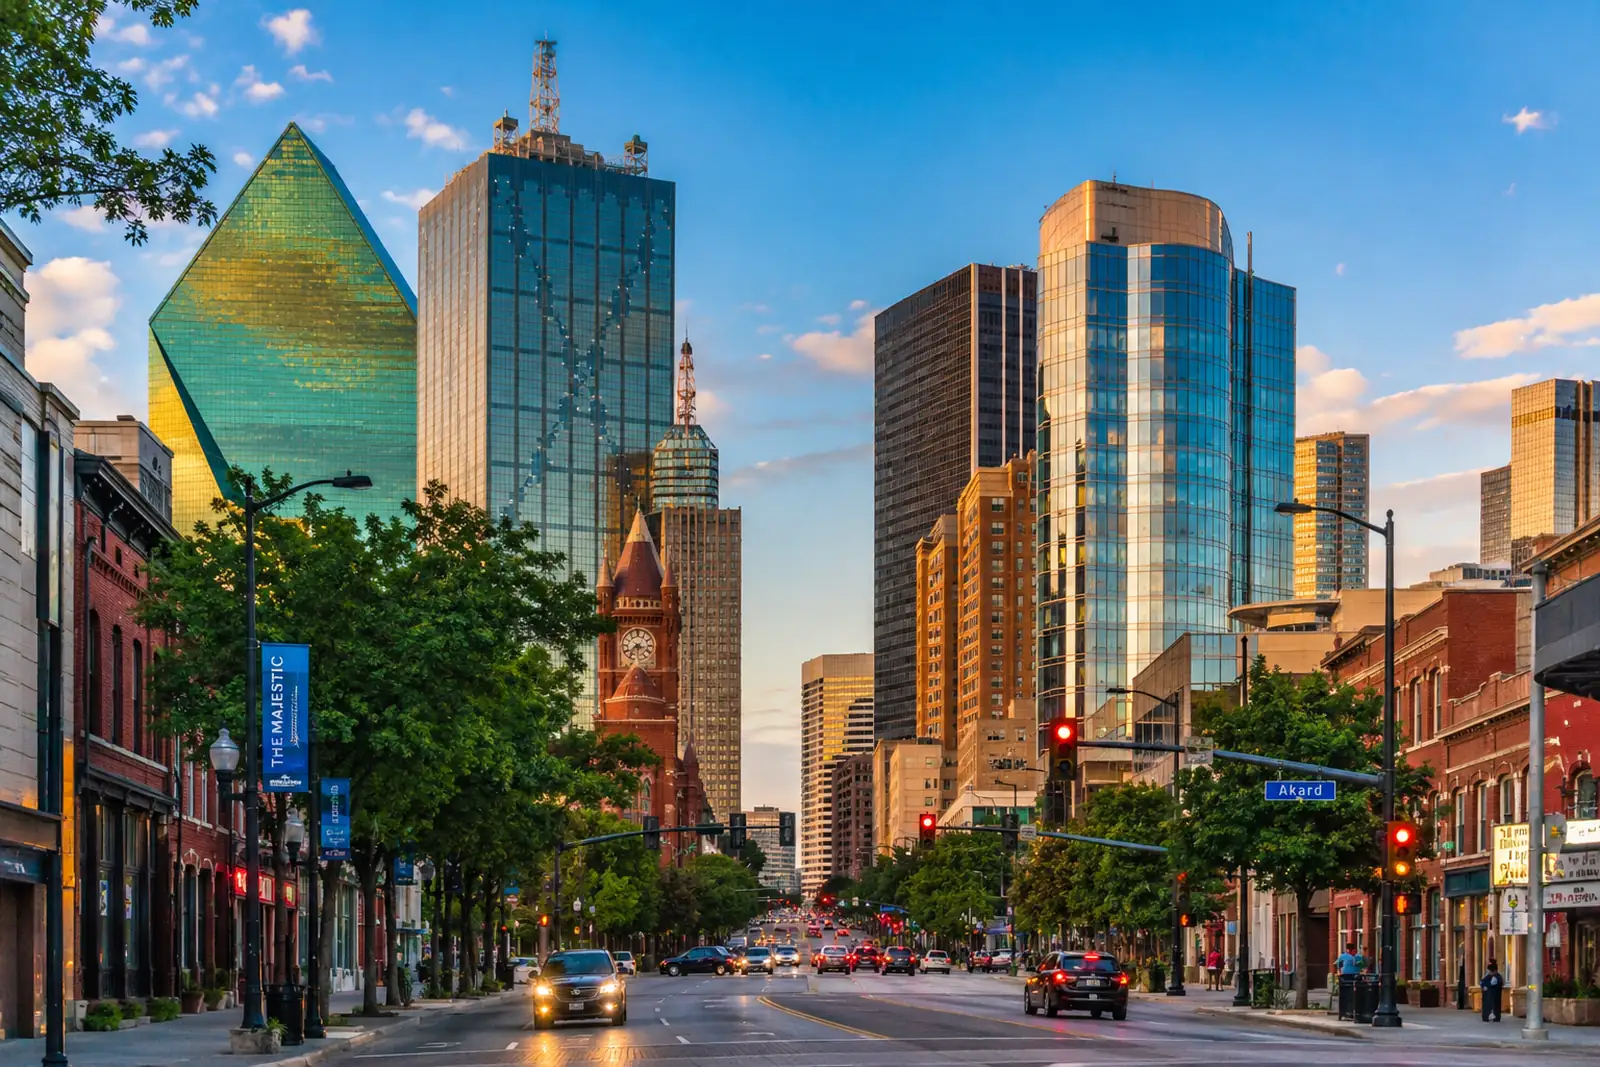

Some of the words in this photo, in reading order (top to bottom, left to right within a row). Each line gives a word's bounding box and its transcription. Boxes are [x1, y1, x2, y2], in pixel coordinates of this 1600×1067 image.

[271, 656, 284, 734] MAJESTIC
[271, 737, 284, 768] THE
[1278, 784, 1322, 796] Akard
